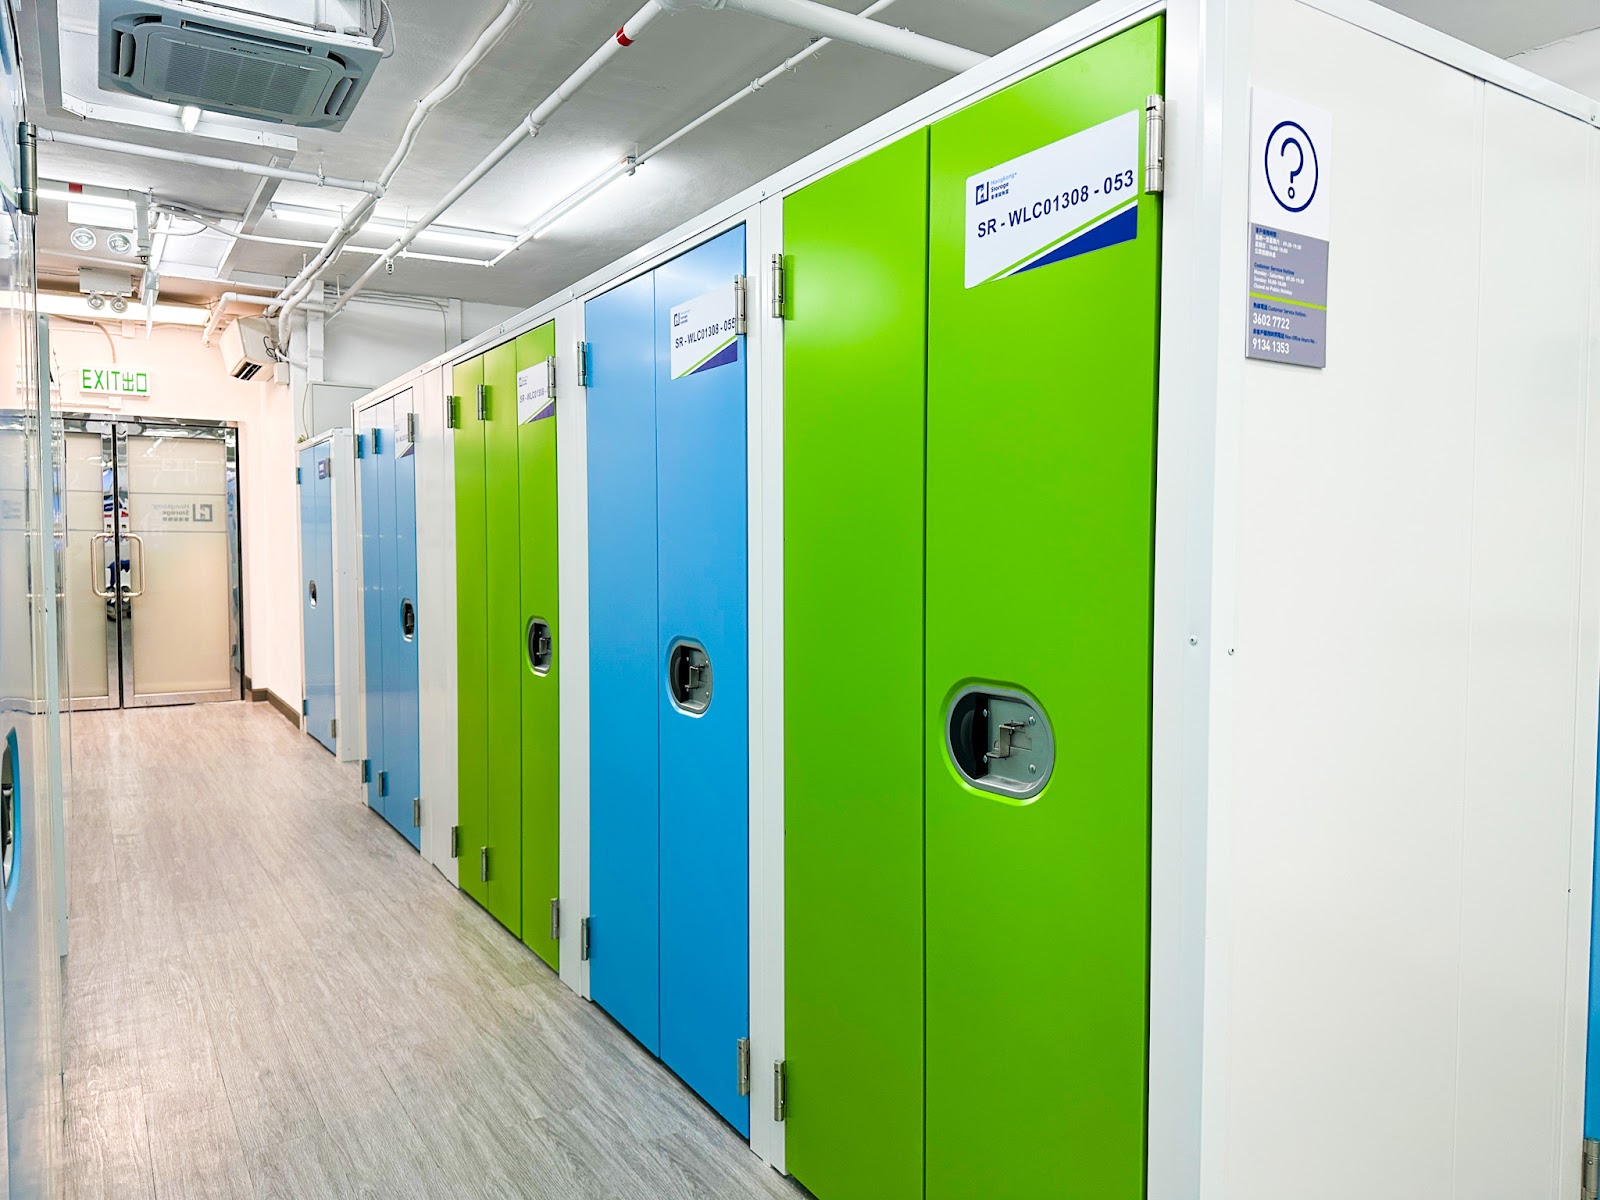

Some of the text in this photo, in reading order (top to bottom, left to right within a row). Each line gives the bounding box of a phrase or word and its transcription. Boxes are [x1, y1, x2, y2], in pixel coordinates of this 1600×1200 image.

[991, 182, 1008, 192] Storage
[978, 218, 996, 238] SR
[1008, 185, 1088, 227] WLC01308
[1104, 170, 1134, 194] 053
[1253, 312, 1290, 329] 3602 7722
[675, 336, 684, 348] SR
[1253, 338, 1290, 354] 9134 1353
